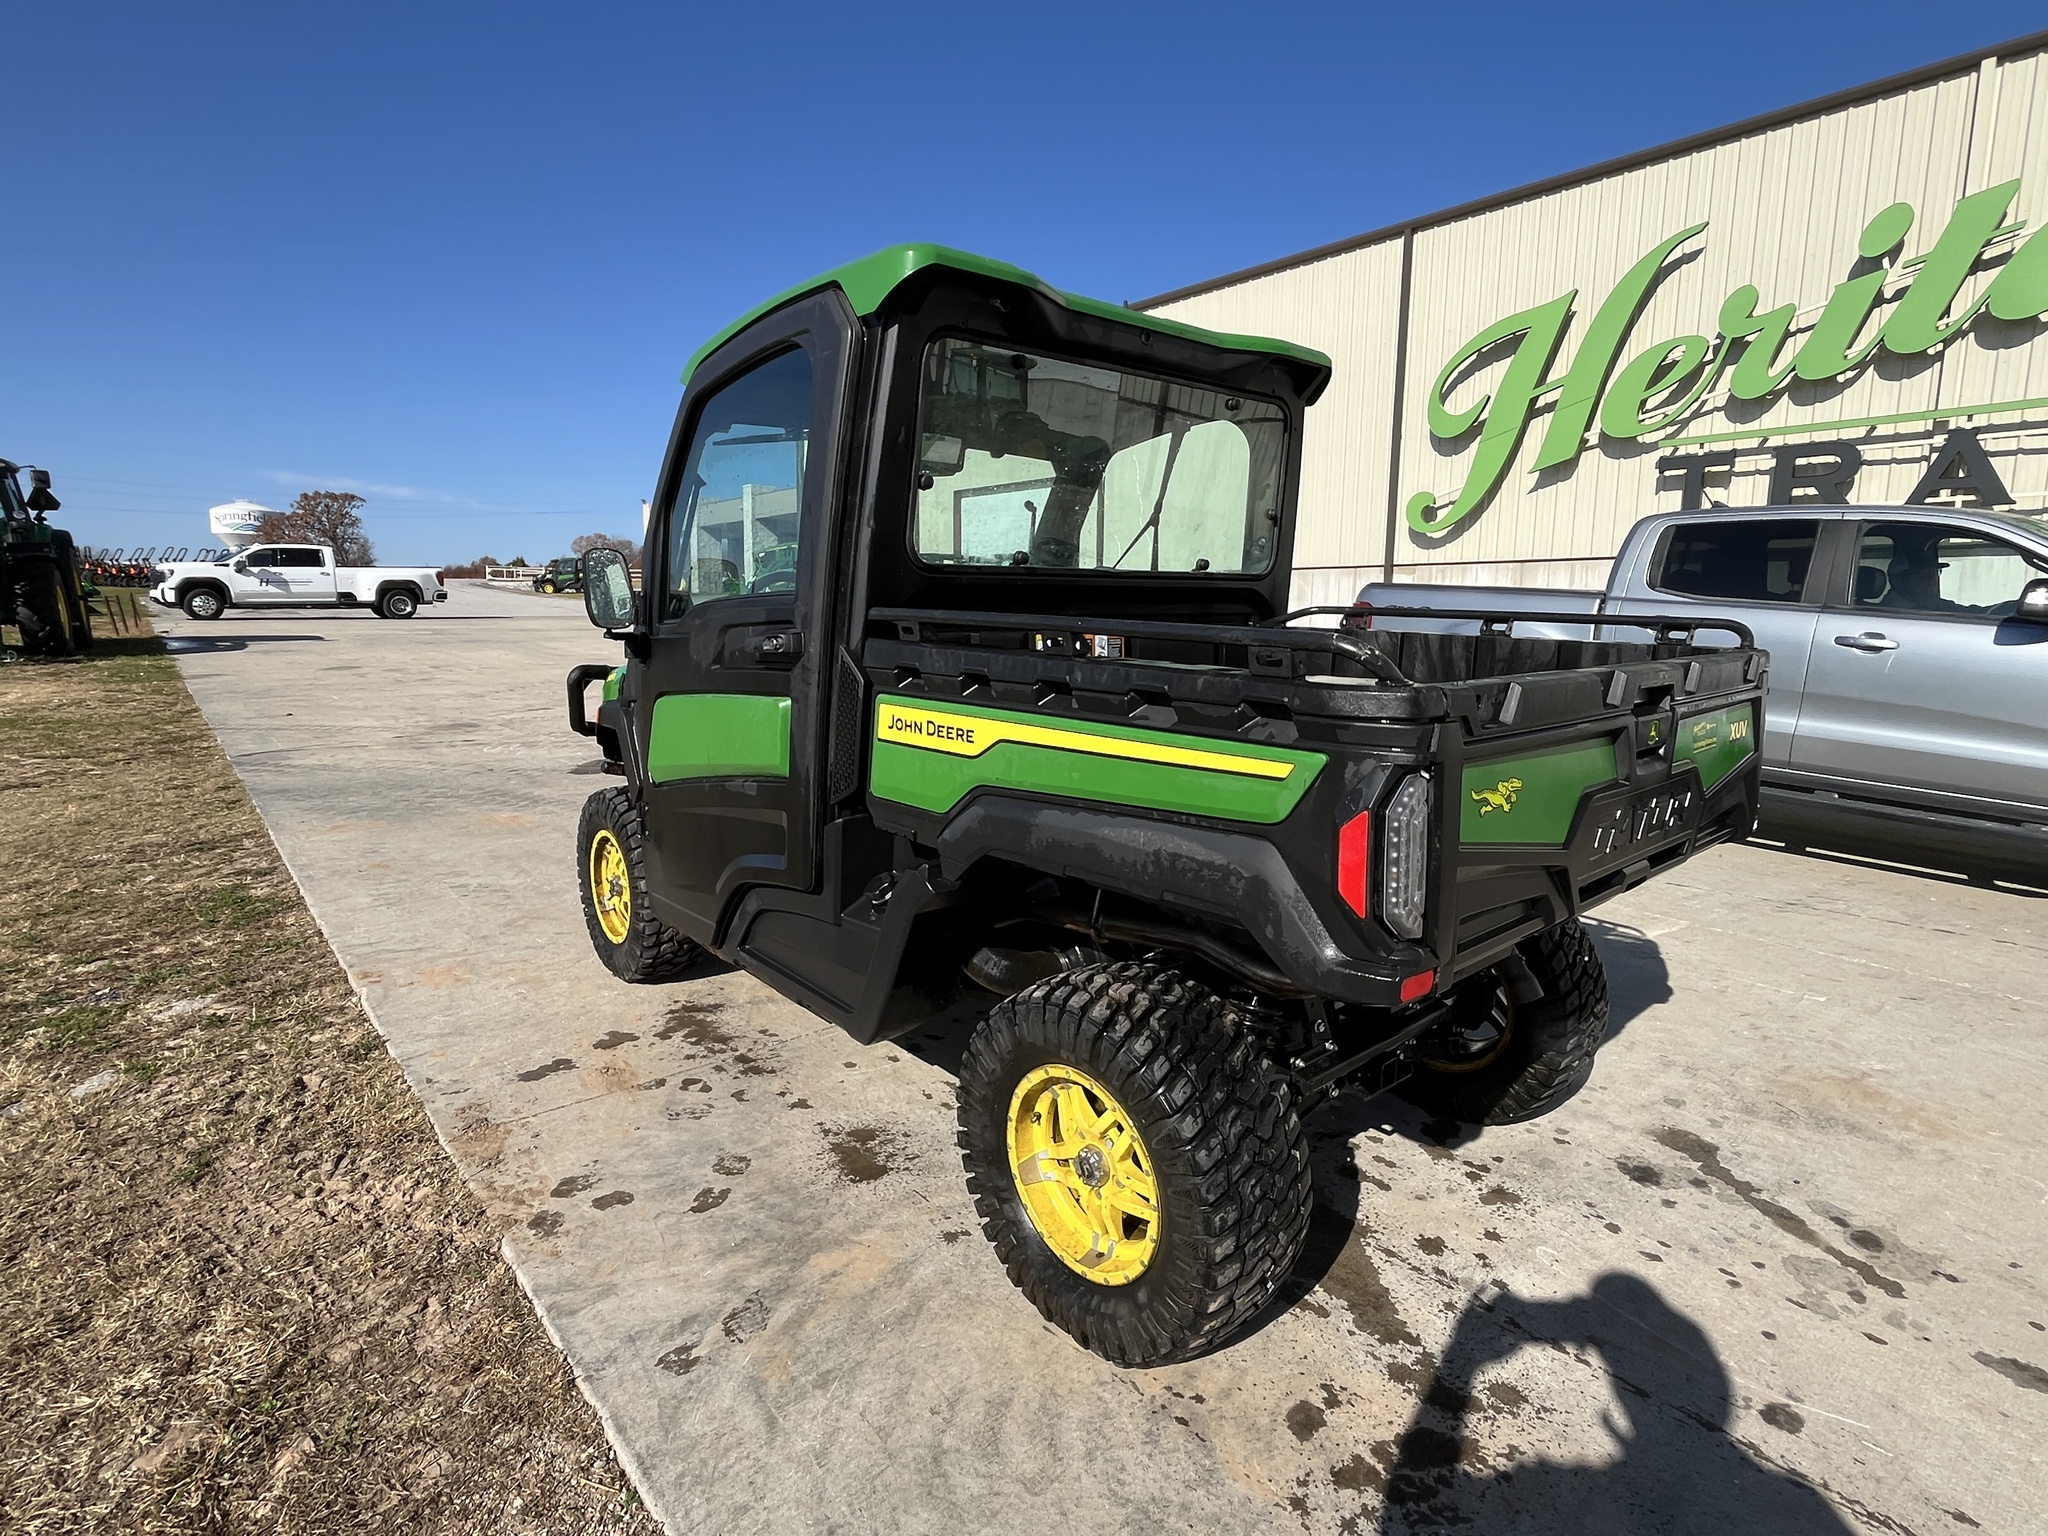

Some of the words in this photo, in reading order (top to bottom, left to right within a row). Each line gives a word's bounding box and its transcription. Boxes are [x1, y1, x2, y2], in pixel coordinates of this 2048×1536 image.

[1655, 428, 2016, 509] TRA
[214, 510, 269, 524] Springfiel
[888, 714, 922, 734] JOHN
[926, 720, 975, 744] DEERE
[1729, 719, 1748, 741] XUV
